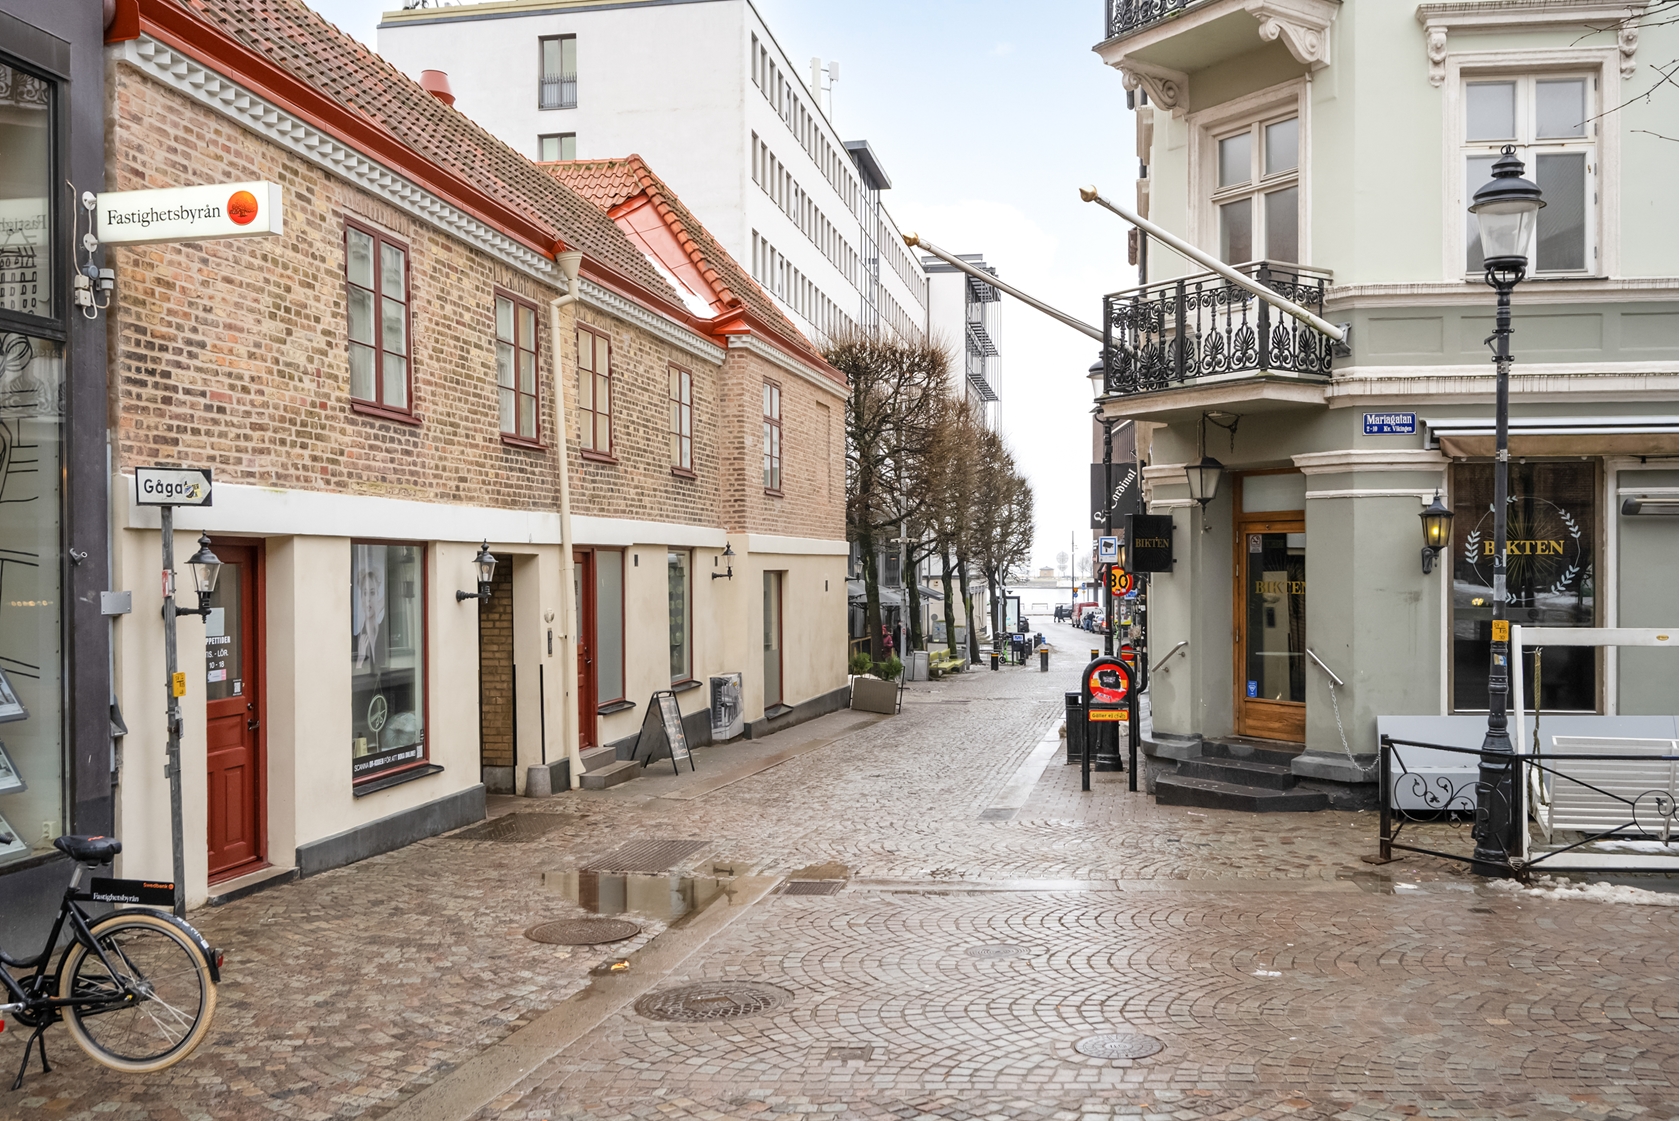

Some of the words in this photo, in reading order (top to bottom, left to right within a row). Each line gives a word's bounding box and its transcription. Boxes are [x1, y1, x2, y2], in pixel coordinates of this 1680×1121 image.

[107, 204, 221, 227] Fastighetsbyrån
[1366, 414, 1412, 425] Mariagatan
[1135, 538, 1170, 548] BIKTEN
[1483, 540, 1565, 555] BKTEN
[93, 892, 139, 903] Fastighetsbyrån
